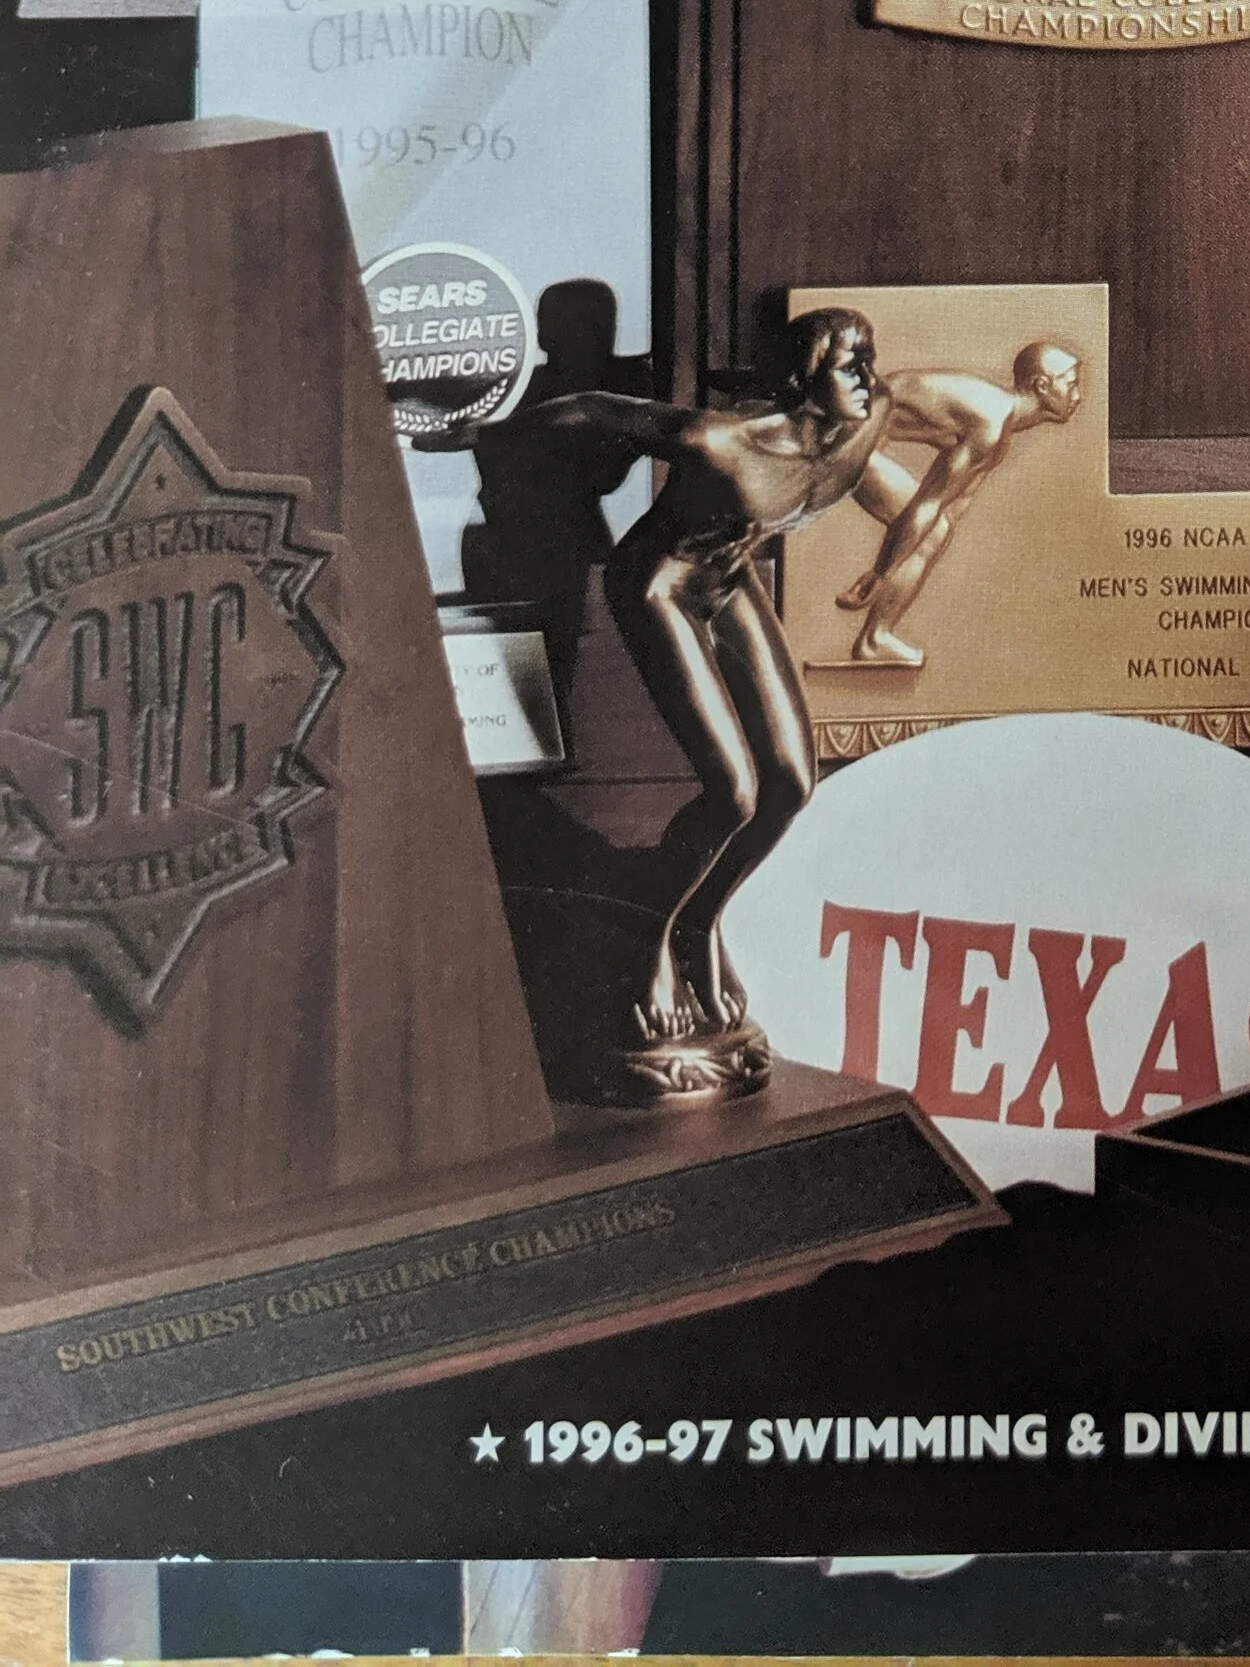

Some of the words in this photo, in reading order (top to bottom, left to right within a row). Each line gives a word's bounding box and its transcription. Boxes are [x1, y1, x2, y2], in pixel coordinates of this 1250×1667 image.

[308, 3, 535, 74] CHAMPION
[335, 121, 517, 168] 1995-96
[376, 279, 489, 315] SEARS
[371, 312, 521, 349] OLLEGIATE
[381, 347, 518, 383] HAMPIONS
[1124, 527, 1173, 550] 1996
[1184, 526, 1247, 547] NCAA
[1079, 576, 1148, 599] MEN'S
[1127, 656, 1241, 679] NATIONAL
[66, 582, 248, 828] SWC
[55, 1301, 256, 1374] SOUTHWEST
[266, 1240, 484, 1323] CONFERENCE
[488, 1199, 678, 1271] CHAMPIONS
[524, 1419, 733, 1464] 1996-97
[746, 1413, 1048, 1464] SWIMMING
[1067, 1412, 1105, 1459] &
